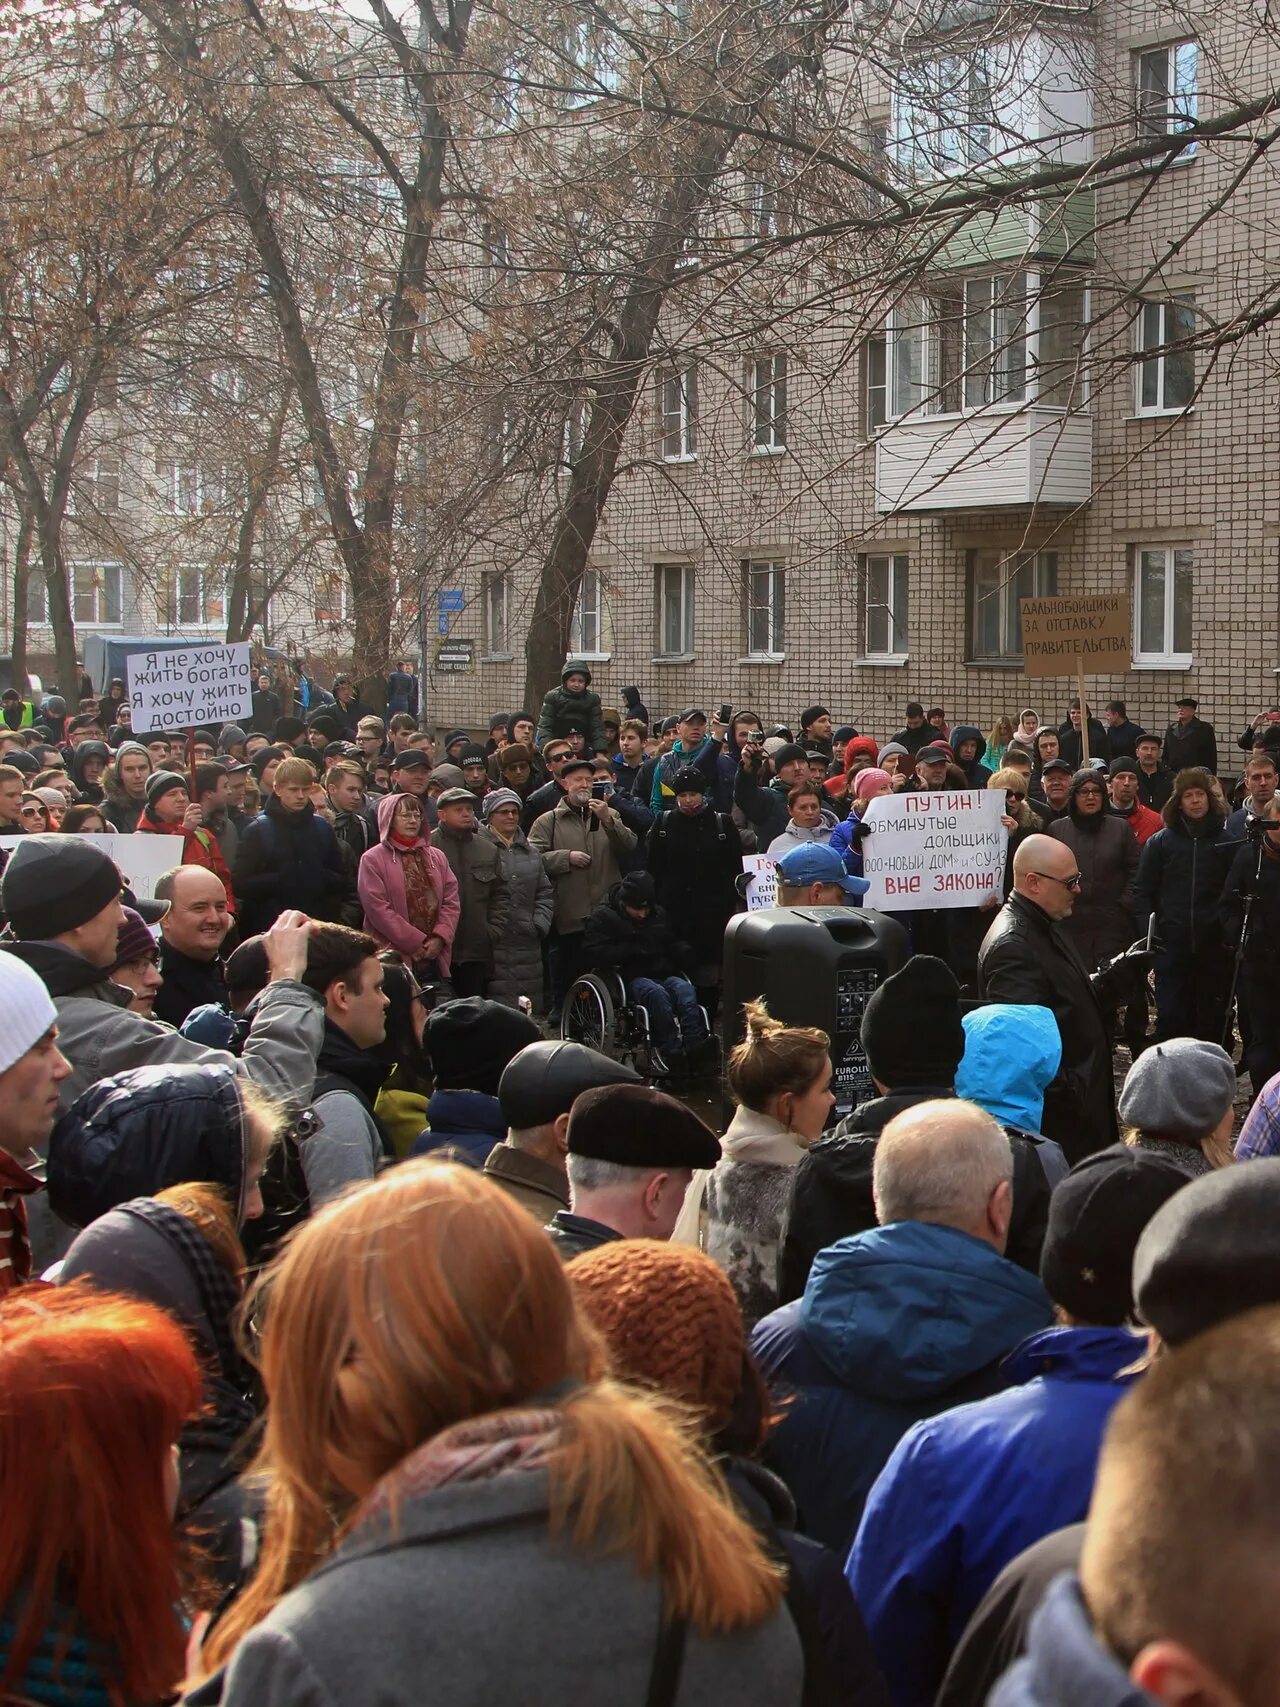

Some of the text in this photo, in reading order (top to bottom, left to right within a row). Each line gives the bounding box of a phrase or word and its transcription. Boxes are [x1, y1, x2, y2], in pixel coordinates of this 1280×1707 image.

[1022, 598, 1119, 615] ДАЛЬНОБОЙЩИКИ
[1024, 615, 1106, 633] ЗА ОТСТАВКУ
[1025, 636, 1127, 656] ПРАВИТЕЛЬСТВА
[146, 648, 236, 670] Я не хочу
[134, 663, 249, 686] жить богато
[132, 683, 248, 709] Я хочу жить
[149, 701, 241, 731] достойно
[923, 832, 1001, 850] ДОЛЬЩИКИ
[835, 1065, 869, 1075] EUROLIV
